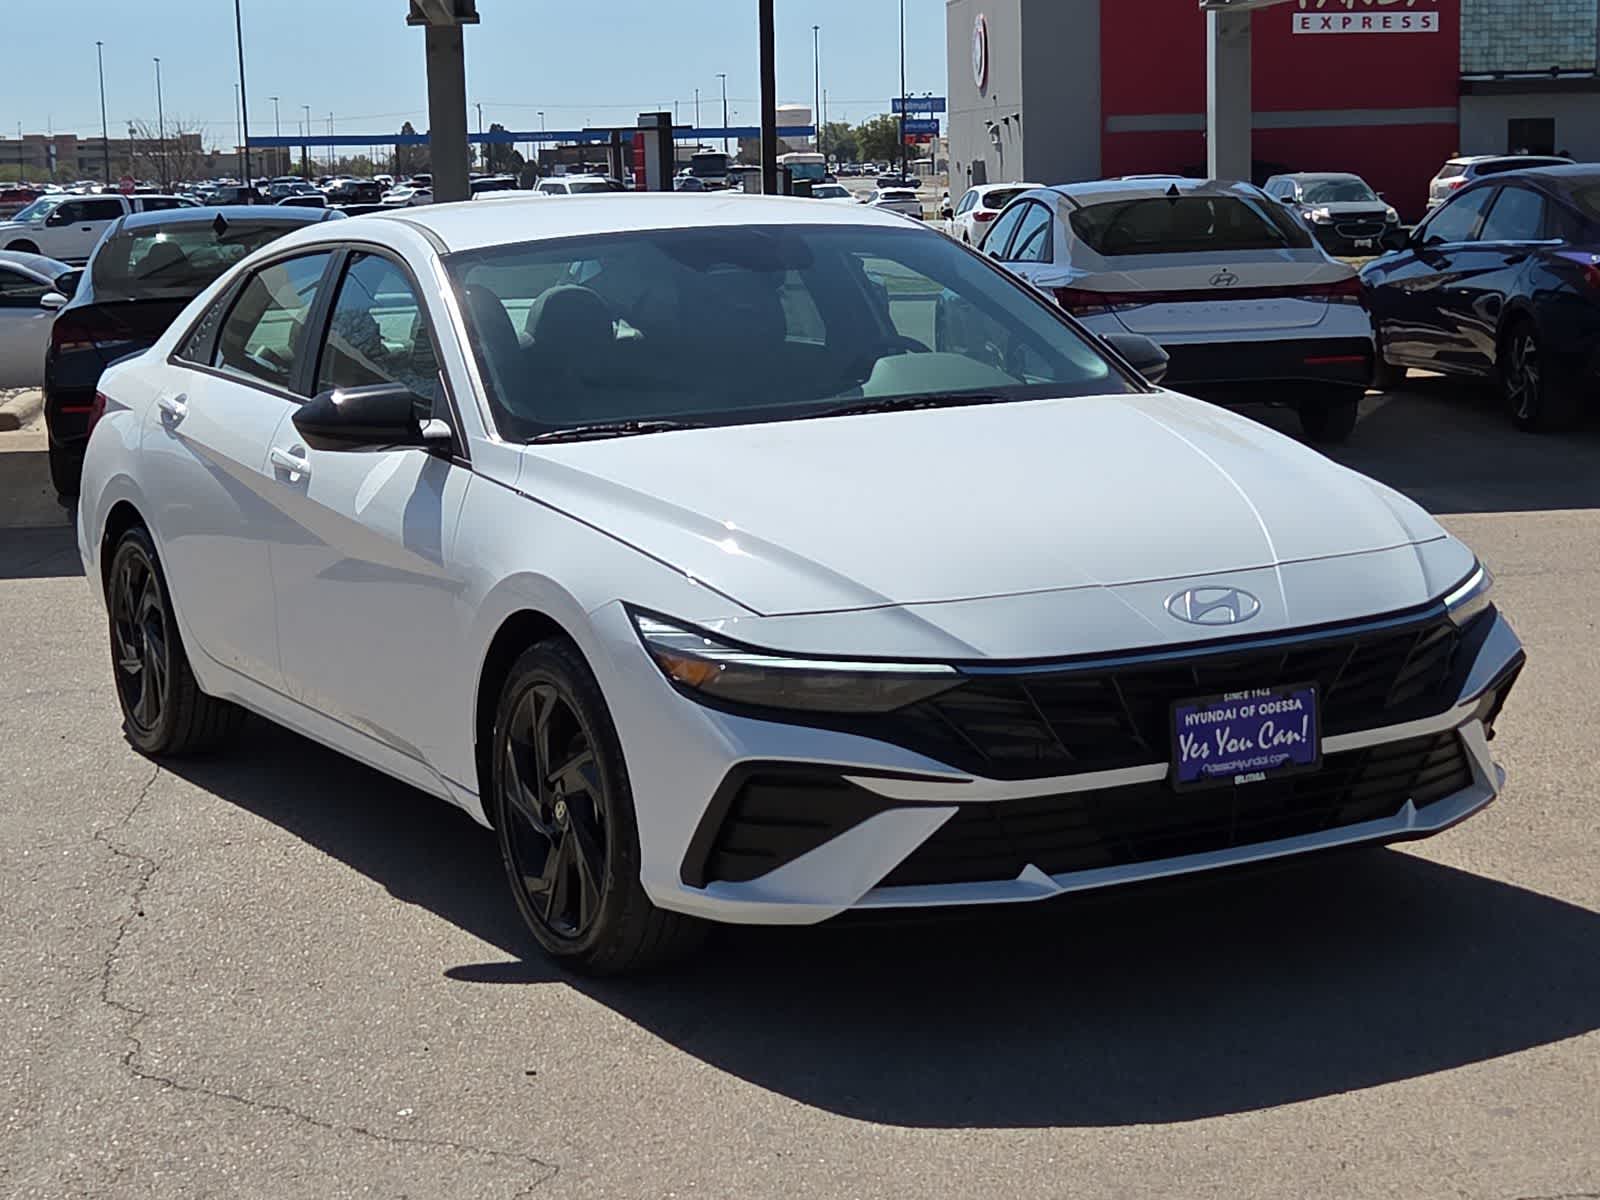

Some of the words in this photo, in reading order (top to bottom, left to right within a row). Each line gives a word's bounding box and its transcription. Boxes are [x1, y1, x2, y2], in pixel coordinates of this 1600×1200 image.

[1301, 16, 1431, 30] EXPRESS
[1224, 690, 1249, 702] SINCE
[1185, 707, 1237, 726] HYUNDAI
[1240, 704, 1255, 718] OF
[1258, 698, 1303, 715] ODESSA
[1179, 732, 1210, 762] Yes
[1215, 726, 1253, 756] You
[1258, 714, 1309, 749] Can!
